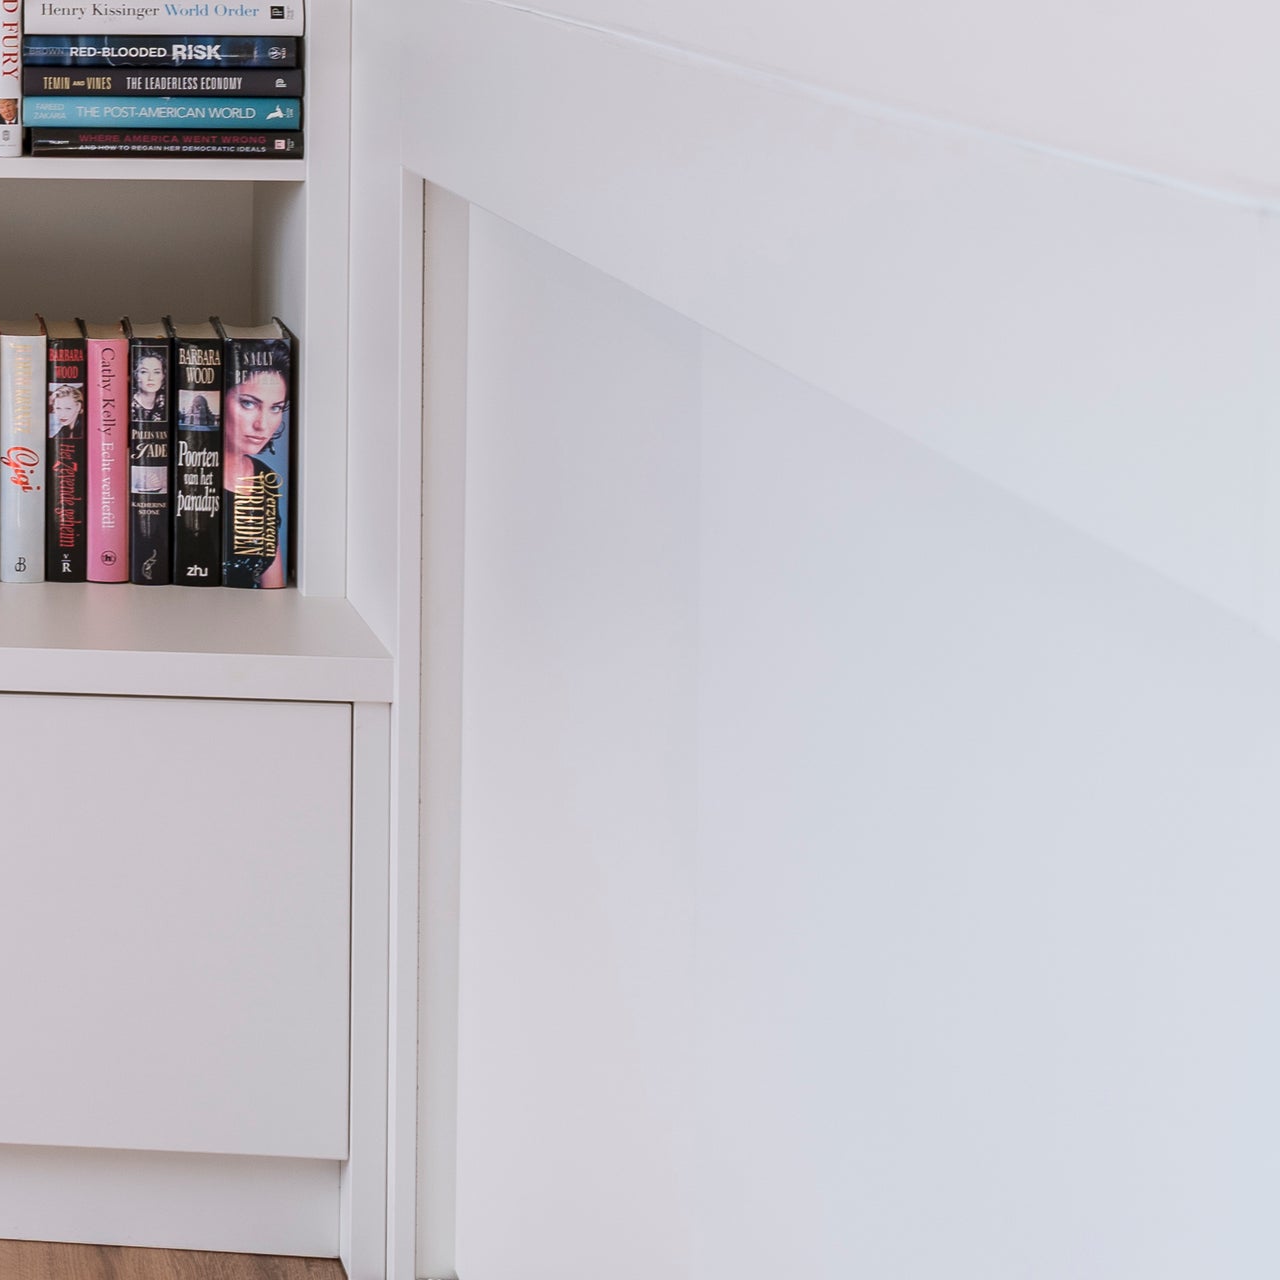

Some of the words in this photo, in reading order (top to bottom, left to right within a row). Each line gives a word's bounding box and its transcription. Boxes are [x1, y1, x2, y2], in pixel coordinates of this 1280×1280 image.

[41, 4, 88, 20] Henry
[92, 4, 160, 20] Kissinger
[164, 4, 209, 17] World
[215, 5, 259, 17] Order
[2, 23, 18, 80] FURY
[70, 47, 166, 58] RED-BLOODED
[172, 44, 222, 60] RISK
[76, 106, 102, 118] THE
[104, 107, 205, 118] POST-AMERICAN
[209, 108, 256, 118] WORLD
[97, 348, 116, 391] Cathy
[178, 349, 221, 365] BARBARA
[186, 367, 214, 384] WOOD
[98, 398, 117, 436] Kelly
[178, 441, 219, 467] Poorten
[0, 446, 41, 493] Gigi
[233, 472, 264, 556] VERLEDEN
